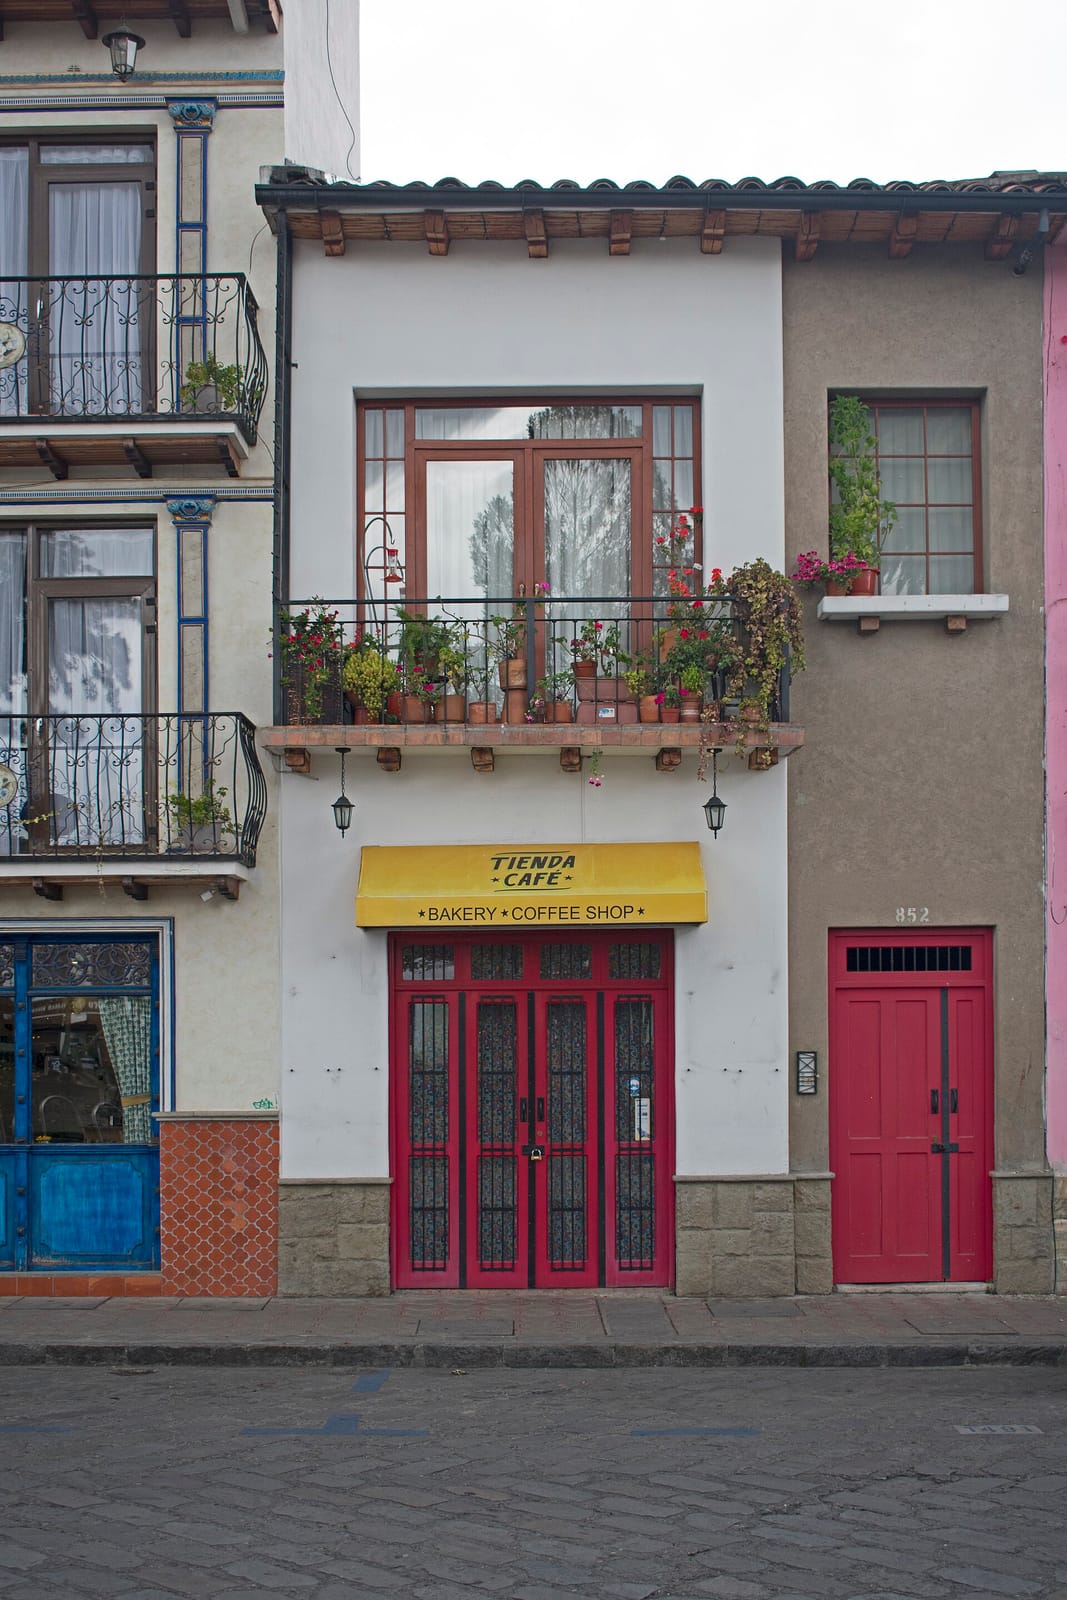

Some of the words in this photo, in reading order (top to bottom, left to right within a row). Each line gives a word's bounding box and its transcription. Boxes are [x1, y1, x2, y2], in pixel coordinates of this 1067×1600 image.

[490, 855, 576, 870] TIENDA
[503, 869, 562, 887] CAFÉ
[428, 907, 497, 921] BAKERY
[511, 906, 581, 920] COFFEE
[585, 905, 634, 920] SHOP
[895, 906, 929, 922] 852
